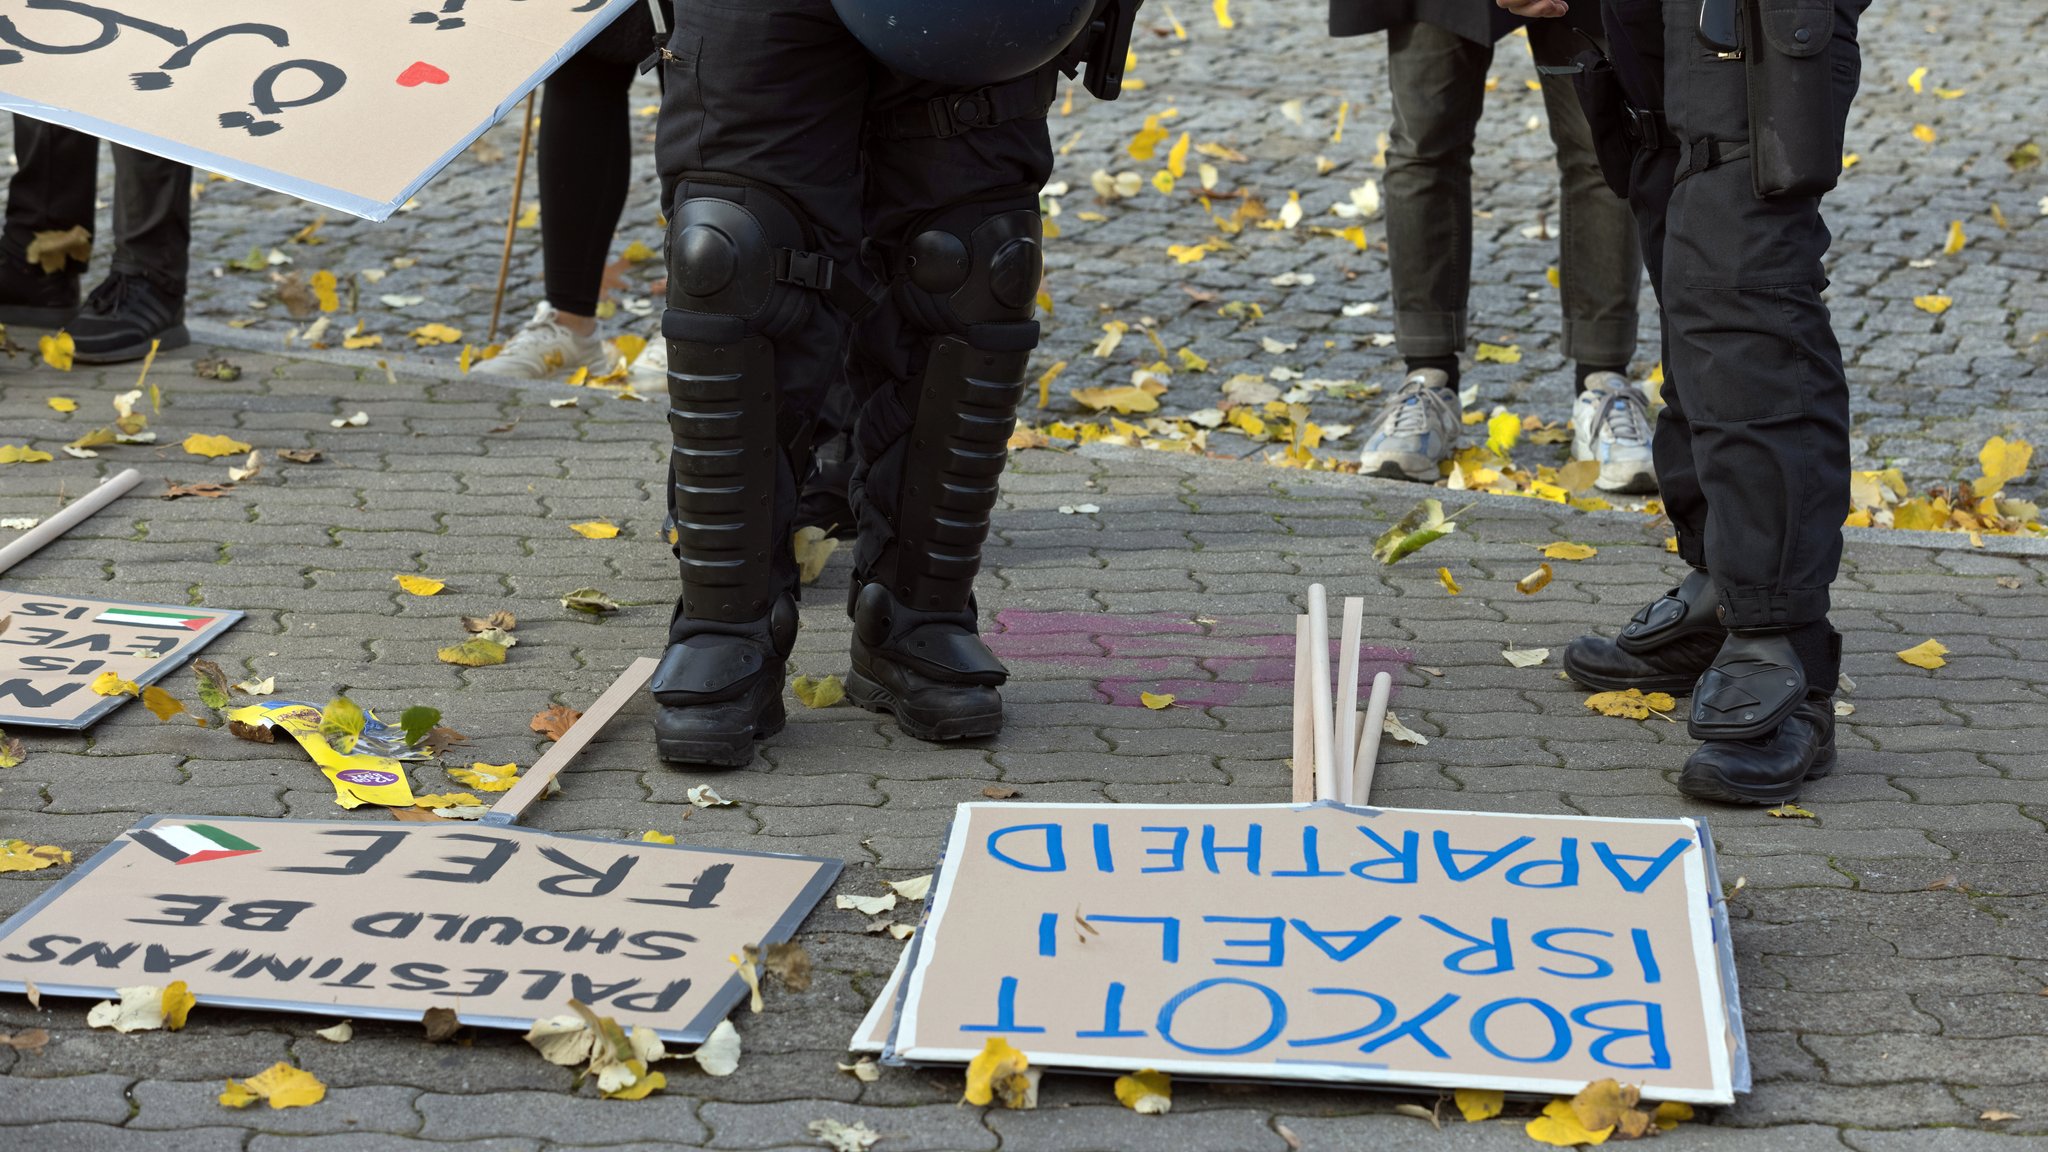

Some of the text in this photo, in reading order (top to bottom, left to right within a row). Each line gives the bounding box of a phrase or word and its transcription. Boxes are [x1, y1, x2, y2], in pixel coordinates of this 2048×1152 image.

[11, 602, 90, 620] IS
[17, 656, 107, 675] IS
[268, 827, 735, 910] FREE
[986, 823, 1692, 894] APARTHEID
[127, 893, 697, 961] SHOULD BE
[1038, 912, 1662, 984] ISRAELI
[4, 934, 692, 1013] PALESTINIANS
[961, 976, 1673, 1071] BOYCOTT
